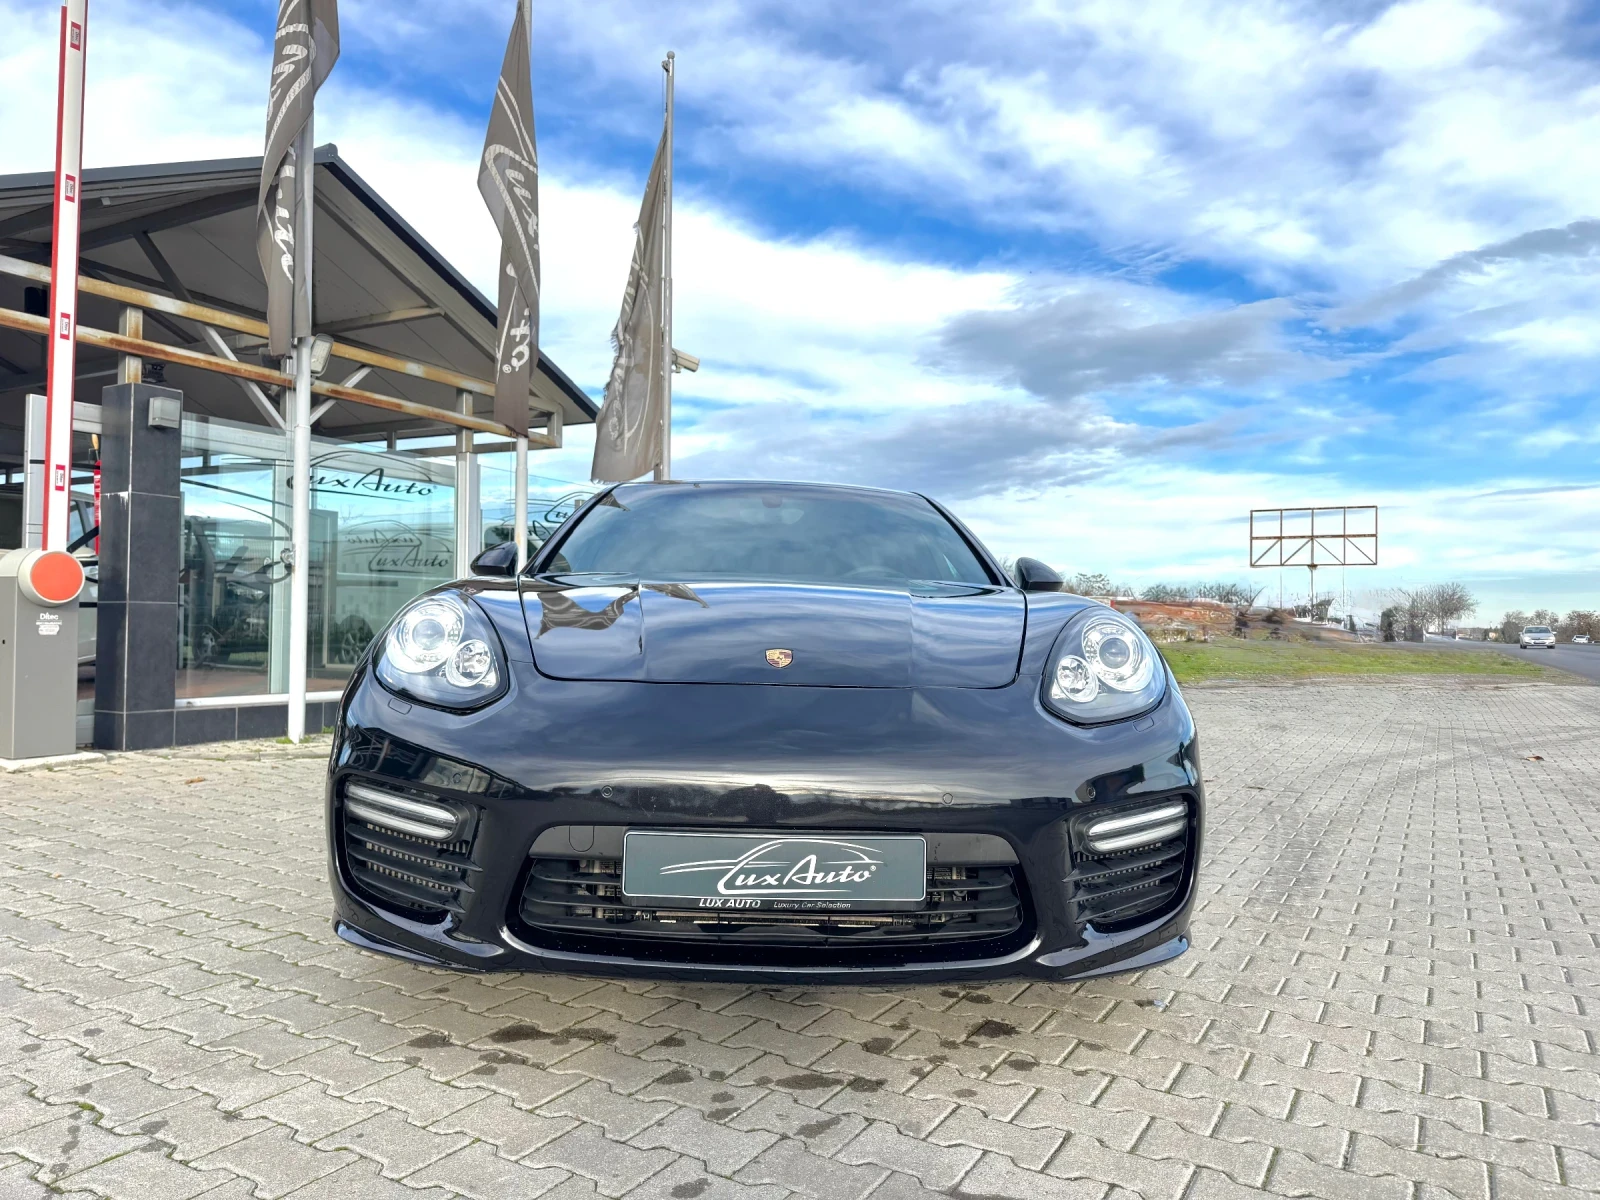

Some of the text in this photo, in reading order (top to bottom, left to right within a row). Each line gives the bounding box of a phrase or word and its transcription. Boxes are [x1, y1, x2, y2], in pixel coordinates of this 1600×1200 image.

[717, 852, 782, 895] Lux
[699, 898, 724, 908] LUX
[725, 899, 762, 908] AUTO
[773, 901, 800, 910] Luxury
[816, 902, 851, 910] Selection
